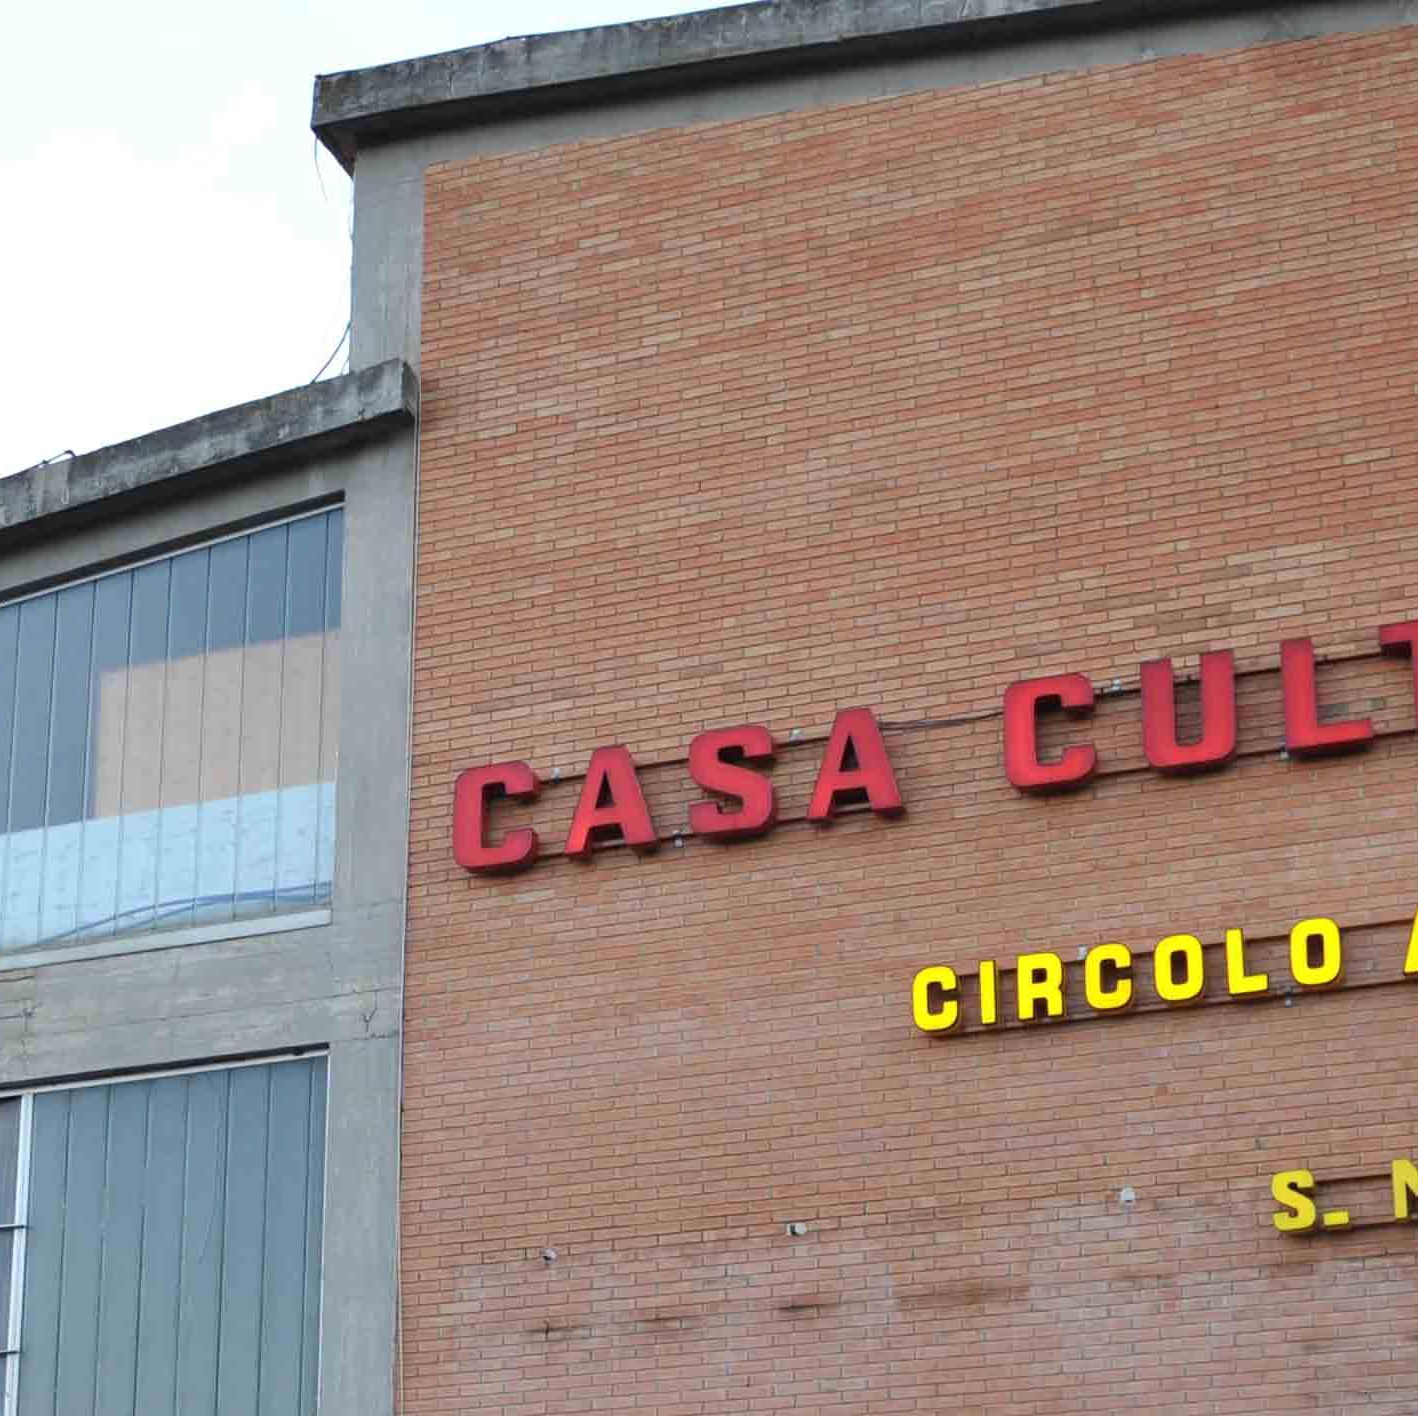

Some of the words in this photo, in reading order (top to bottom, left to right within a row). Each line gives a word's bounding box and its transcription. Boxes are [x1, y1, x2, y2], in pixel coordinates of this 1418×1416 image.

[453, 708, 909, 876] CASA
[912, 916, 1345, 1035] CIRCOLO
[1271, 1167, 1351, 1236] S.
